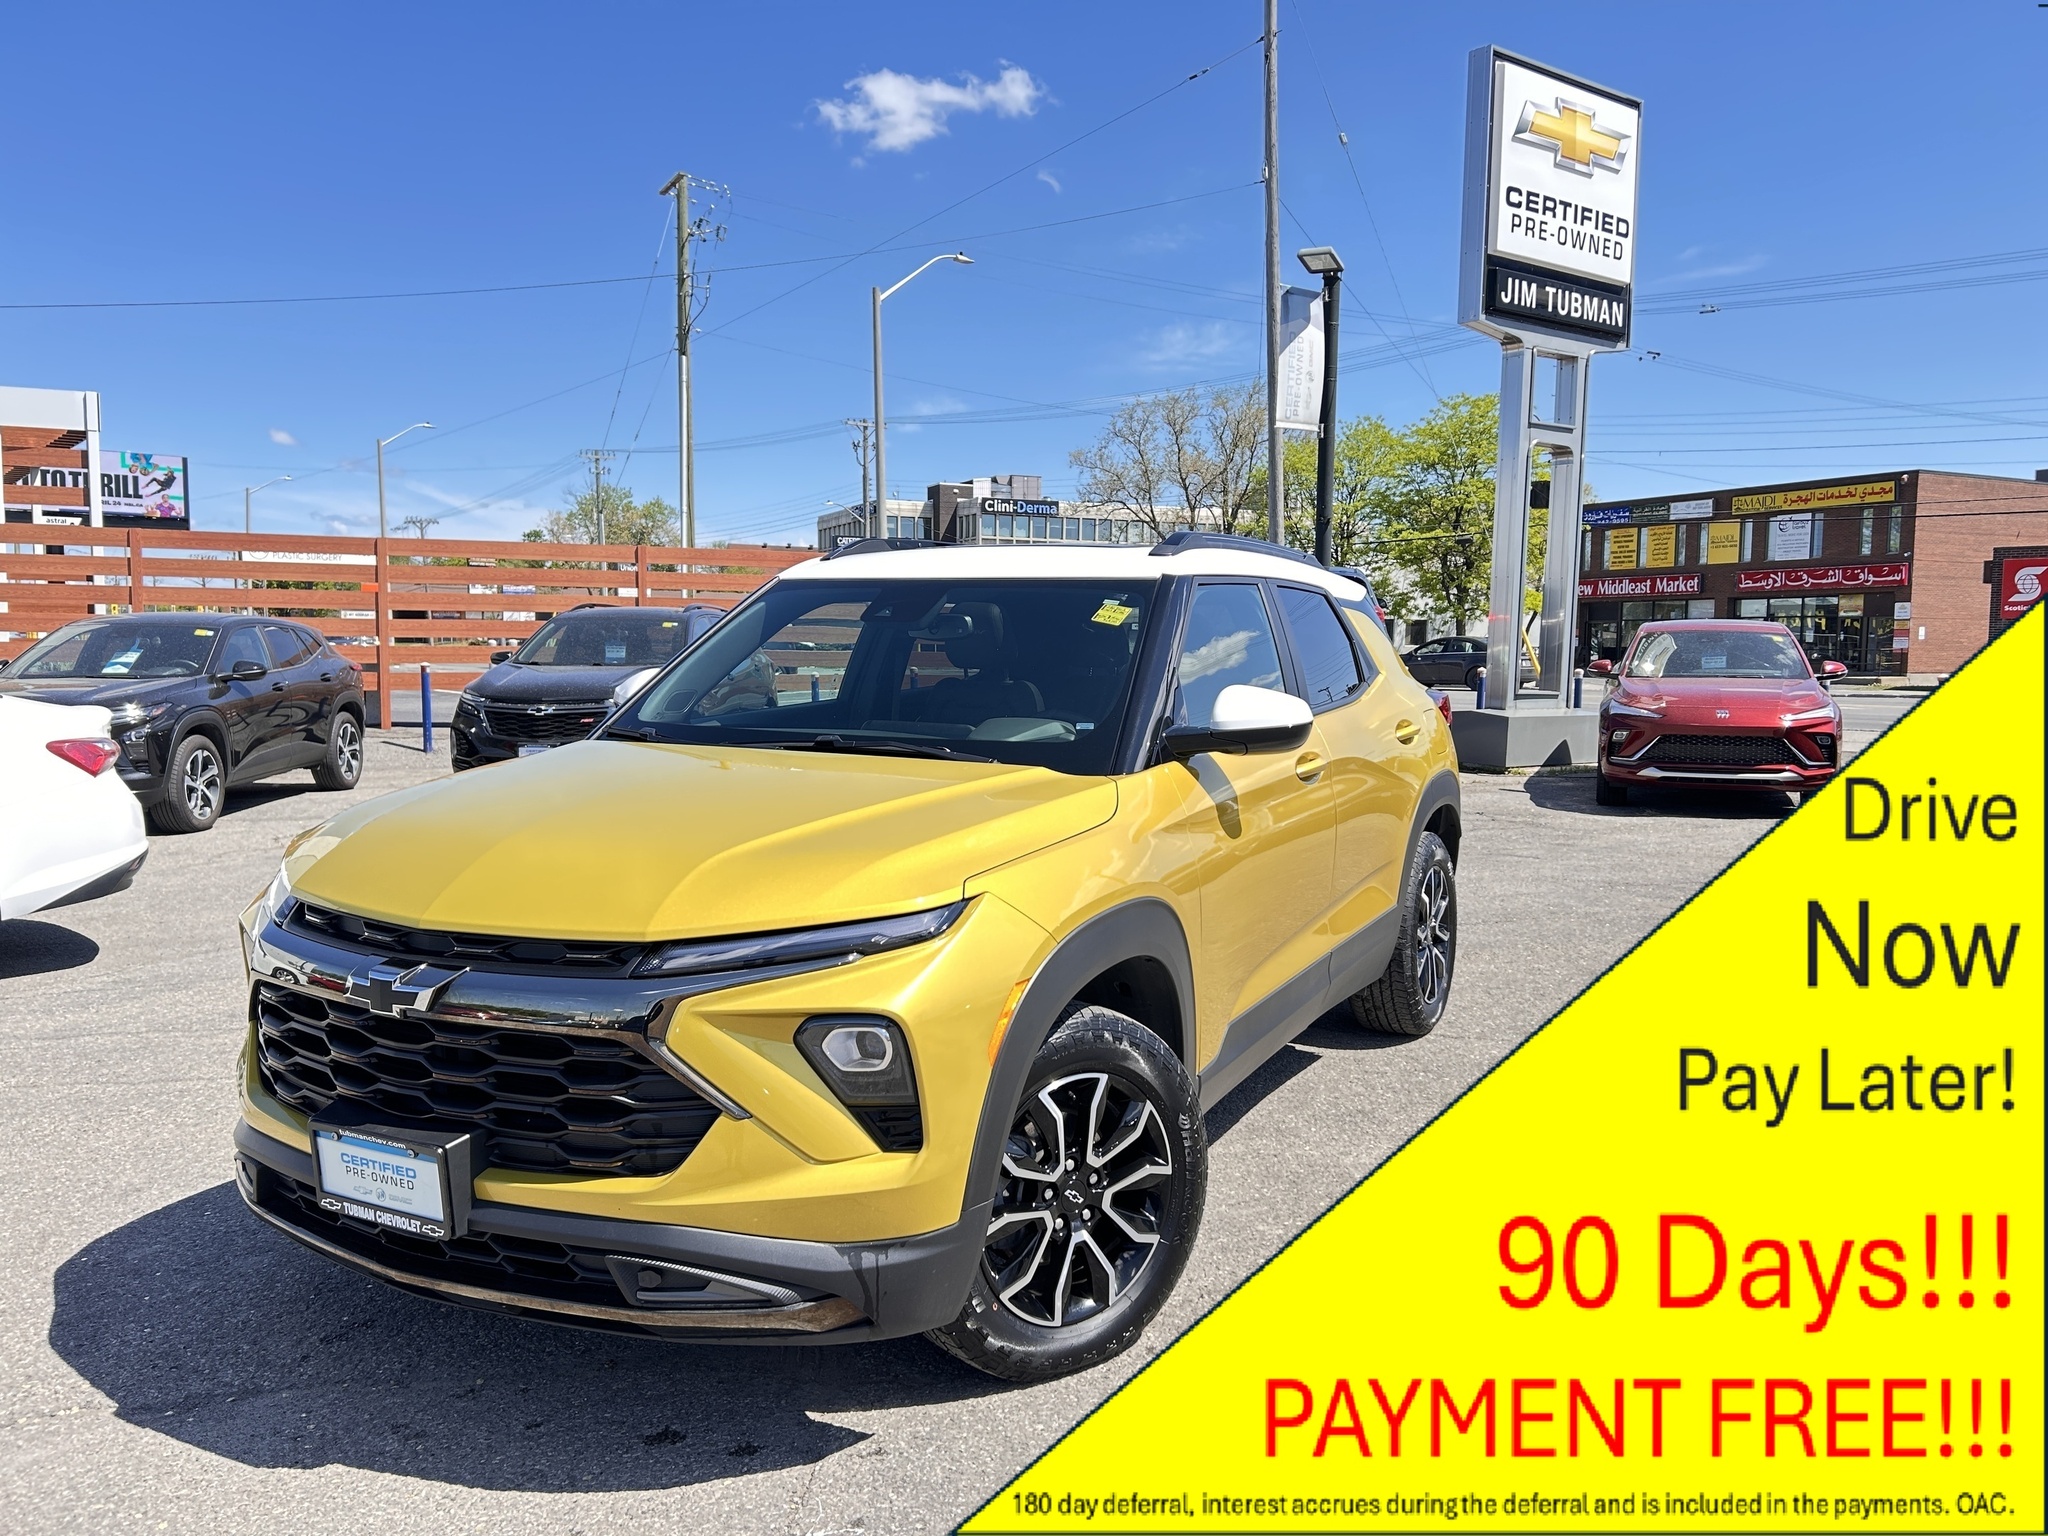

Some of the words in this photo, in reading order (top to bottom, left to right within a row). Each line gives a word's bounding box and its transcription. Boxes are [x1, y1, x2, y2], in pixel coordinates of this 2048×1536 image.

[1506, 186, 1630, 239] CERTIFIED
[1511, 213, 1623, 261] PRE-OWNED
[1501, 277, 1537, 309] JIM
[1545, 286, 1624, 327] TUBMAN
[1284, 331, 1297, 420] CERTIFIED
[1292, 336, 1305, 417] PRE-OWNED
[984, 500, 1058, 515] Clini-Derma
[1743, 495, 1776, 509] MAJDI
[1782, 491, 1816, 507] الهجرة
[272, 551, 303, 561] PLASTIC
[306, 553, 343, 562] SURGERY
[1578, 584, 1594, 596] ew
[1597, 577, 1651, 596] Middleast
[1654, 575, 1699, 593] Market
[339, 1129, 407, 1149] tubmanchev.com
[340, 1152, 417, 1179] CERTIFIED
[346, 1165, 415, 1190] PRE-OWNED
[343, 1202, 375, 1221] TUBMAN
[376, 1211, 422, 1233] CHEVROLET
